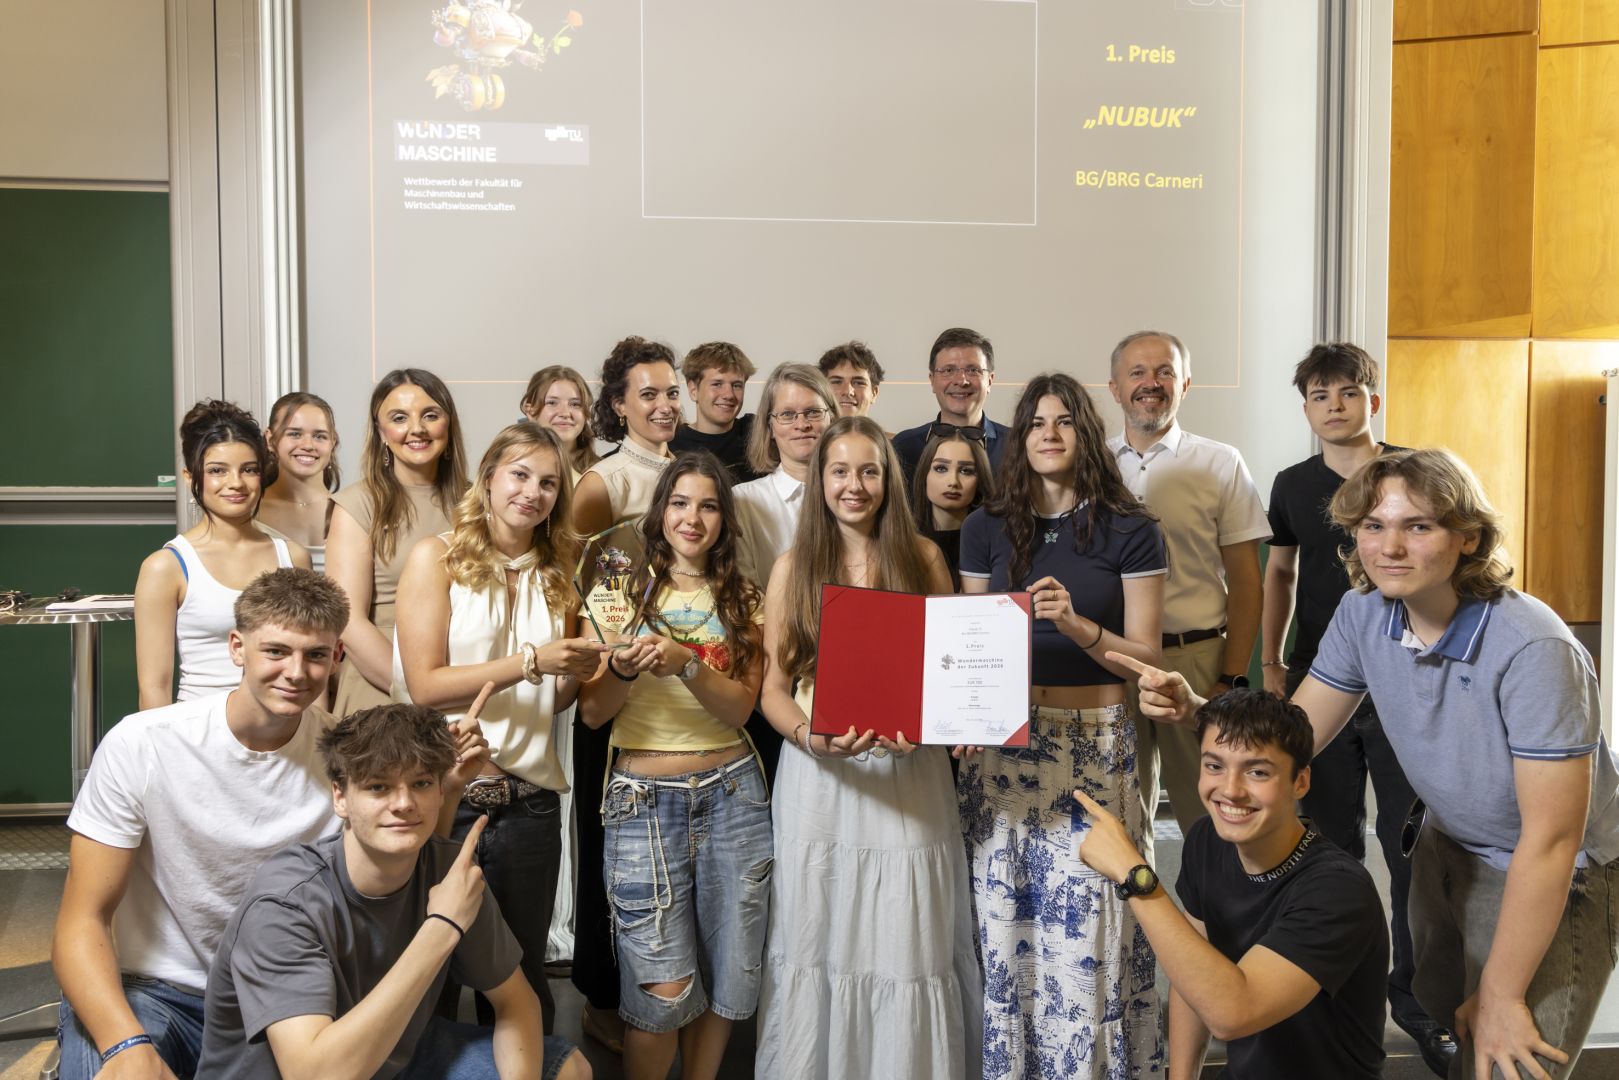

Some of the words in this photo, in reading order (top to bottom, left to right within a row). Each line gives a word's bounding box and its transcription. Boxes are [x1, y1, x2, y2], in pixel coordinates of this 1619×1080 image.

[1106, 44, 1123, 63] 1.
[1129, 44, 1176, 64] Preis
[1083, 105, 1197, 129] „NUBUK“
[398, 144, 497, 162] MASCHINE
[404, 177, 457, 187] Wettbewerb
[458, 178, 473, 187] der
[475, 179, 509, 188] Fakultät
[510, 179, 523, 188] für
[1075, 170, 1141, 189] BG/BRG
[1145, 172, 1203, 189] Carneri
[404, 190, 465, 199] Maschinenbau
[467, 190, 484, 199] und
[404, 201, 516, 212] Wirtschaftswissenschaften
[1266, 851, 1302, 880] NORTH
[1298, 830, 1316, 851] FACE
